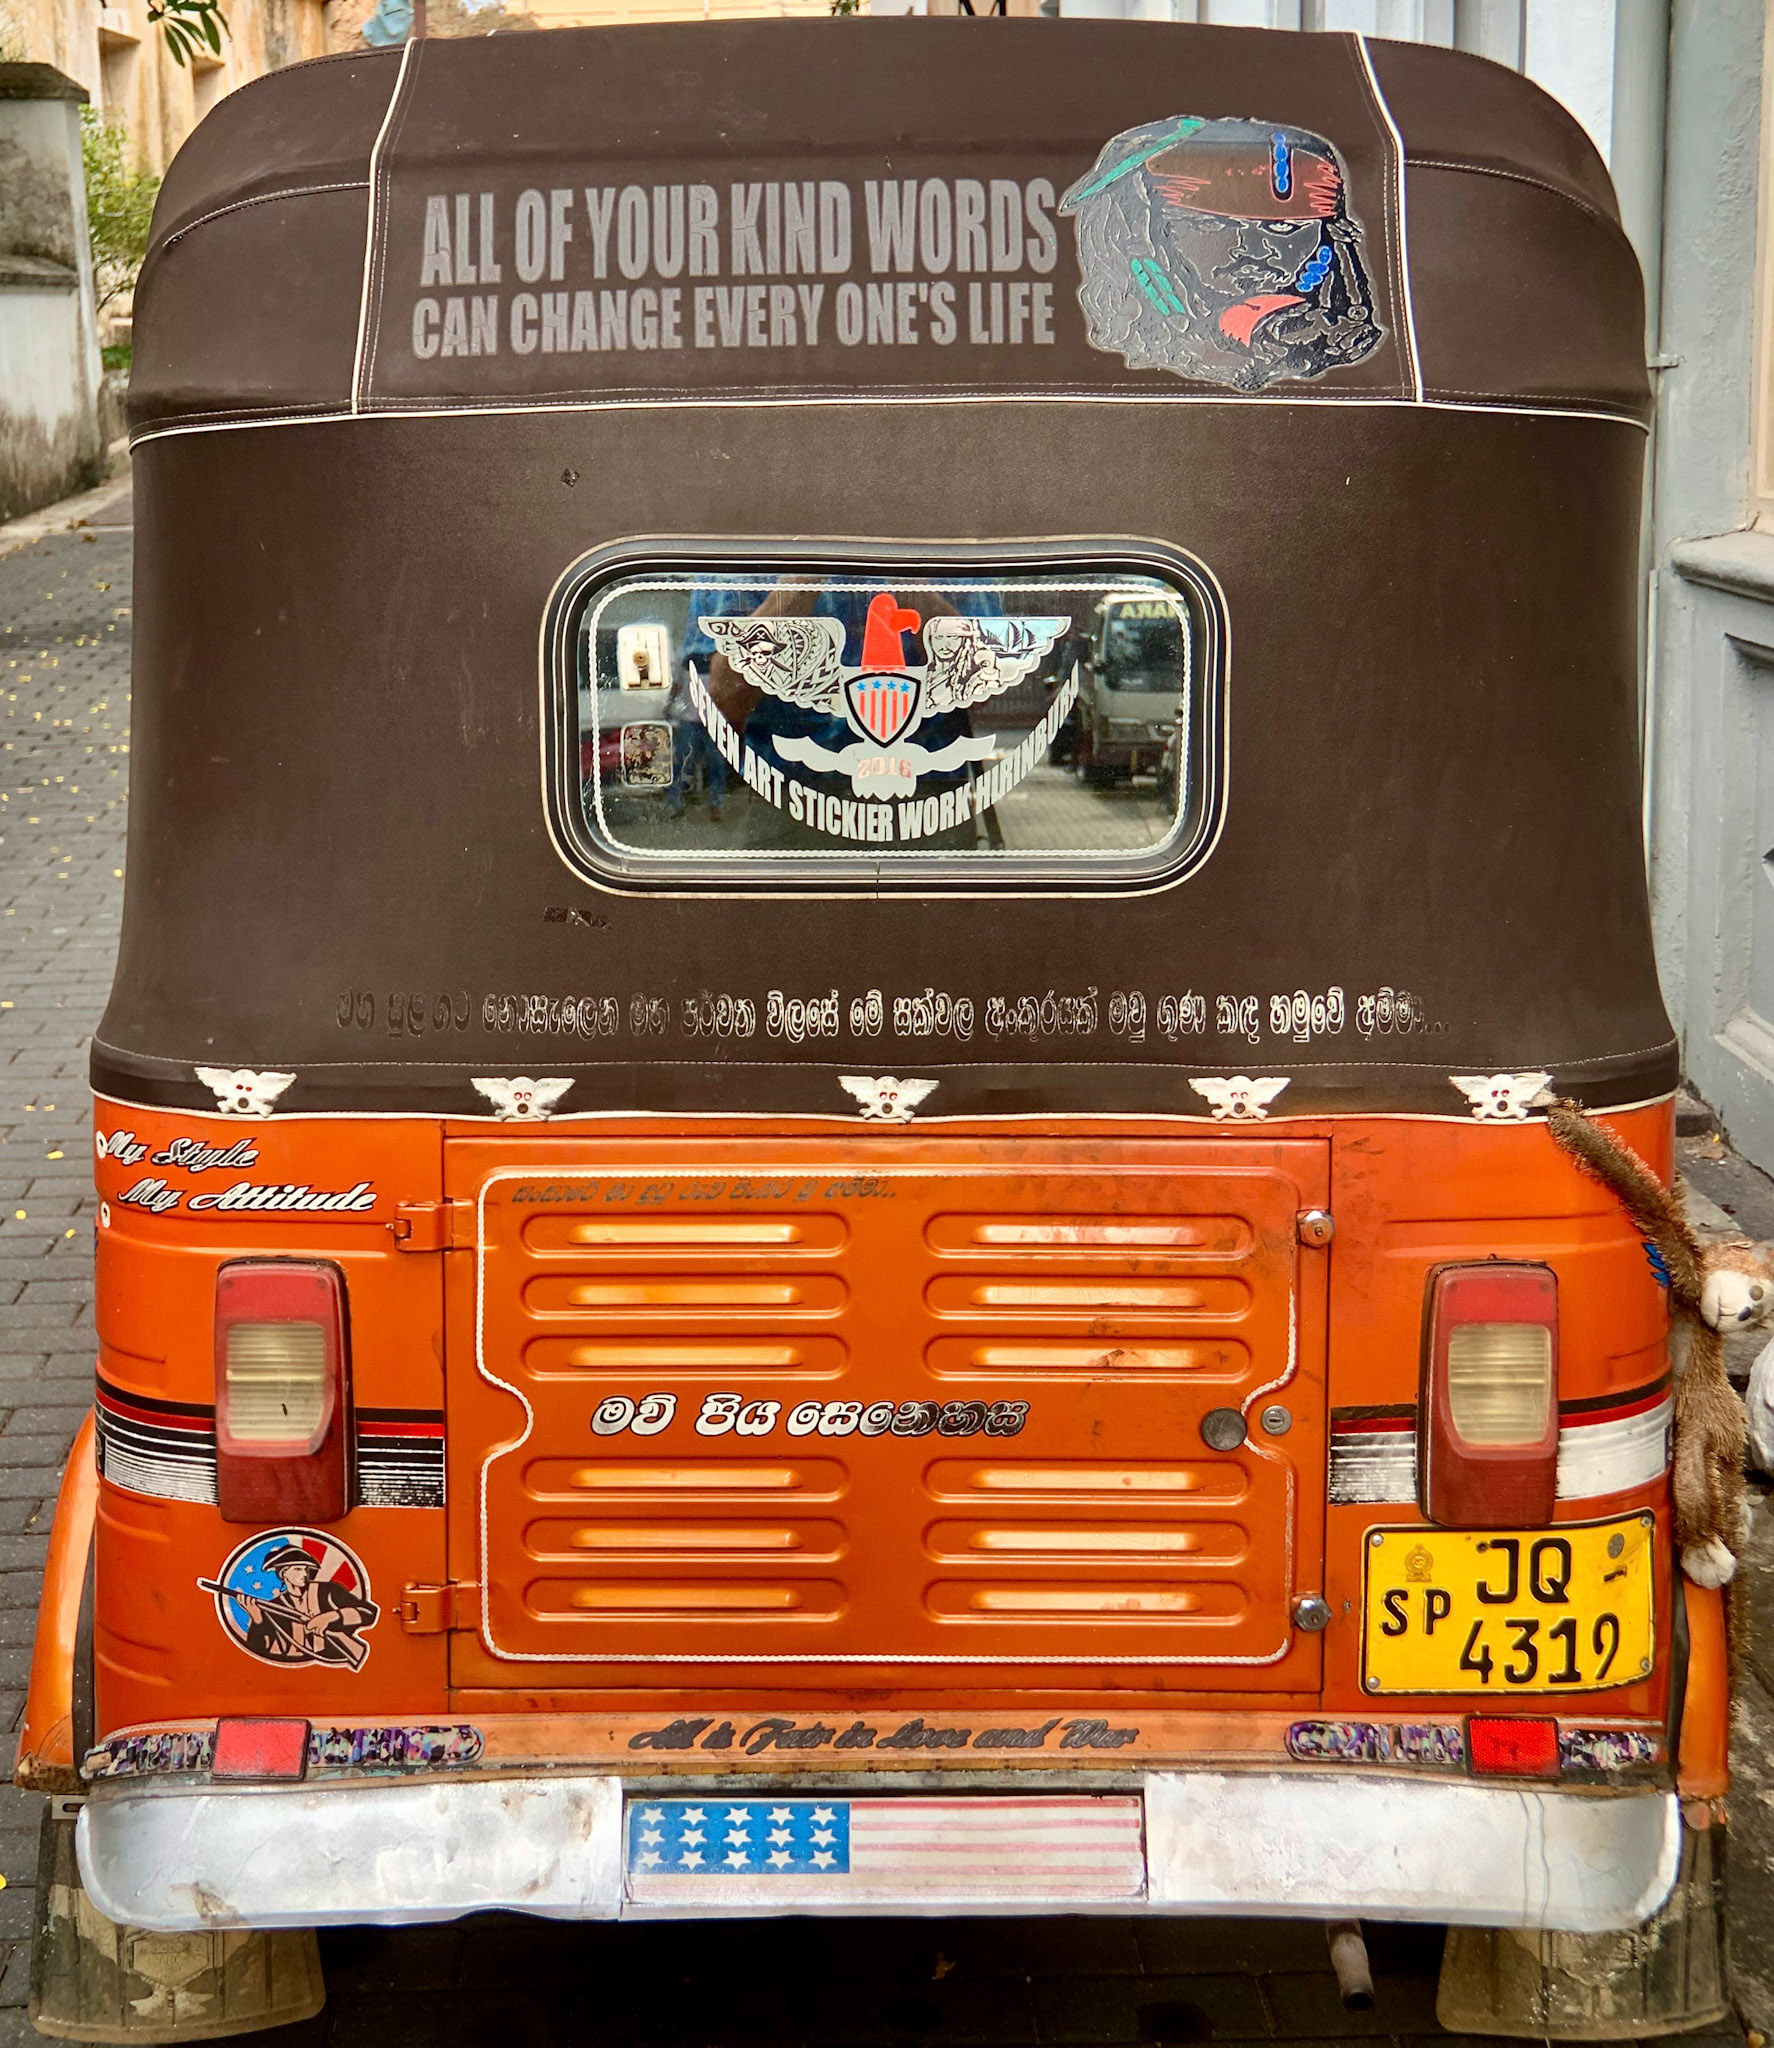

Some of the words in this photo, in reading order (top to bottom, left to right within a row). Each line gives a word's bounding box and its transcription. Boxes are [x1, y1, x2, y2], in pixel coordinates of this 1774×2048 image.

[419, 191, 502, 288] ALL
[513, 188, 574, 284] OF
[585, 184, 720, 280] YOUR
[730, 180, 851, 276] KIND
[864, 177, 1058, 275] WORDS
[411, 294, 499, 359] CAN
[510, 287, 684, 355] CHANGE
[697, 283, 821, 350] EVERY
[835, 281, 958, 347] ONE'S
[969, 281, 1056, 346] LIFE
[688, 659, 740, 774] SEVEN
[743, 744, 785, 810] ART
[788, 779, 894, 842] STICKIER
[898, 782, 972, 841] WORK
[857, 756, 912, 779] 2016
[766, 988, 839, 1043] විලසේ
[849, 987, 884, 1037] මේ
[893, 987, 975, 1041] සක්වල
[1269, 985, 1346, 1043] හමුවේ
[105, 1130, 148, 1167] My
[152, 1136, 260, 1173] Style
[118, 1177, 184, 1213] My
[186, 1180, 378, 1213] Attitude
[590, 1391, 677, 1437] මව්
[694, 1391, 782, 1437] පිය
[785, 1399, 1032, 1438] සෙනෙහස
[1476, 1537, 1573, 1604] JQ
[1458, 1610, 1620, 1684] 4319
[628, 1718, 716, 1750] All
[834, 1720, 878, 1749] in
[876, 1717, 972, 1749] Love
[973, 1717, 1064, 1749] and
[1060, 1718, 1140, 1749] War
